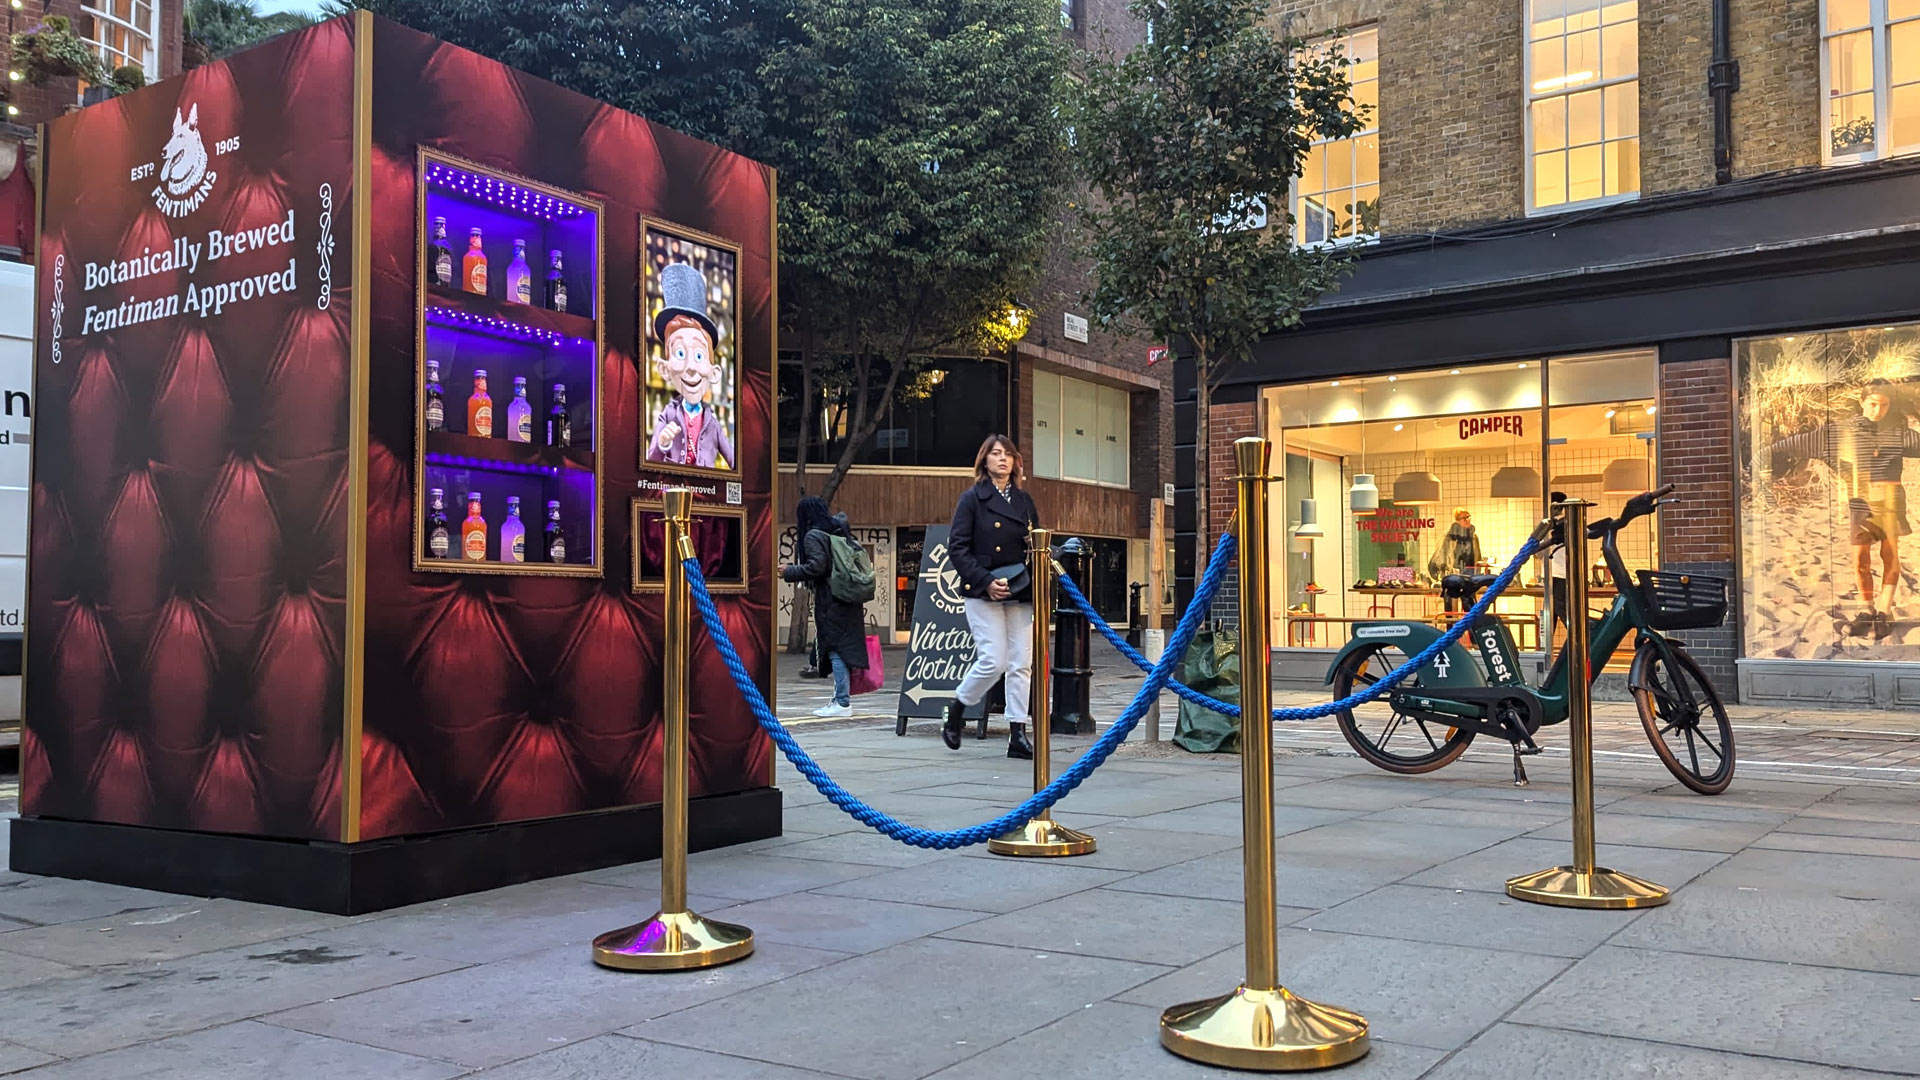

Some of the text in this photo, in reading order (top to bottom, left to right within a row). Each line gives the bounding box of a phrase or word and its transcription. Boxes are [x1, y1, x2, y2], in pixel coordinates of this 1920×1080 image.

[215, 136, 240, 156] 1905
[151, 170, 217, 218] FENTIMANS
[84, 209, 295, 291] Botanically Brewed
[81, 258, 297, 335] Fentiman Approved
[1459, 414, 1523, 440] CAMPER
[1356, 518, 1435, 531] THE WALKING
[1375, 507, 1414, 517] We are
[1371, 531, 1419, 543] SOCIETY
[930, 592, 966, 614] LOND
[911, 621, 977, 662] Vintag
[1481, 629, 1512, 682] forest
